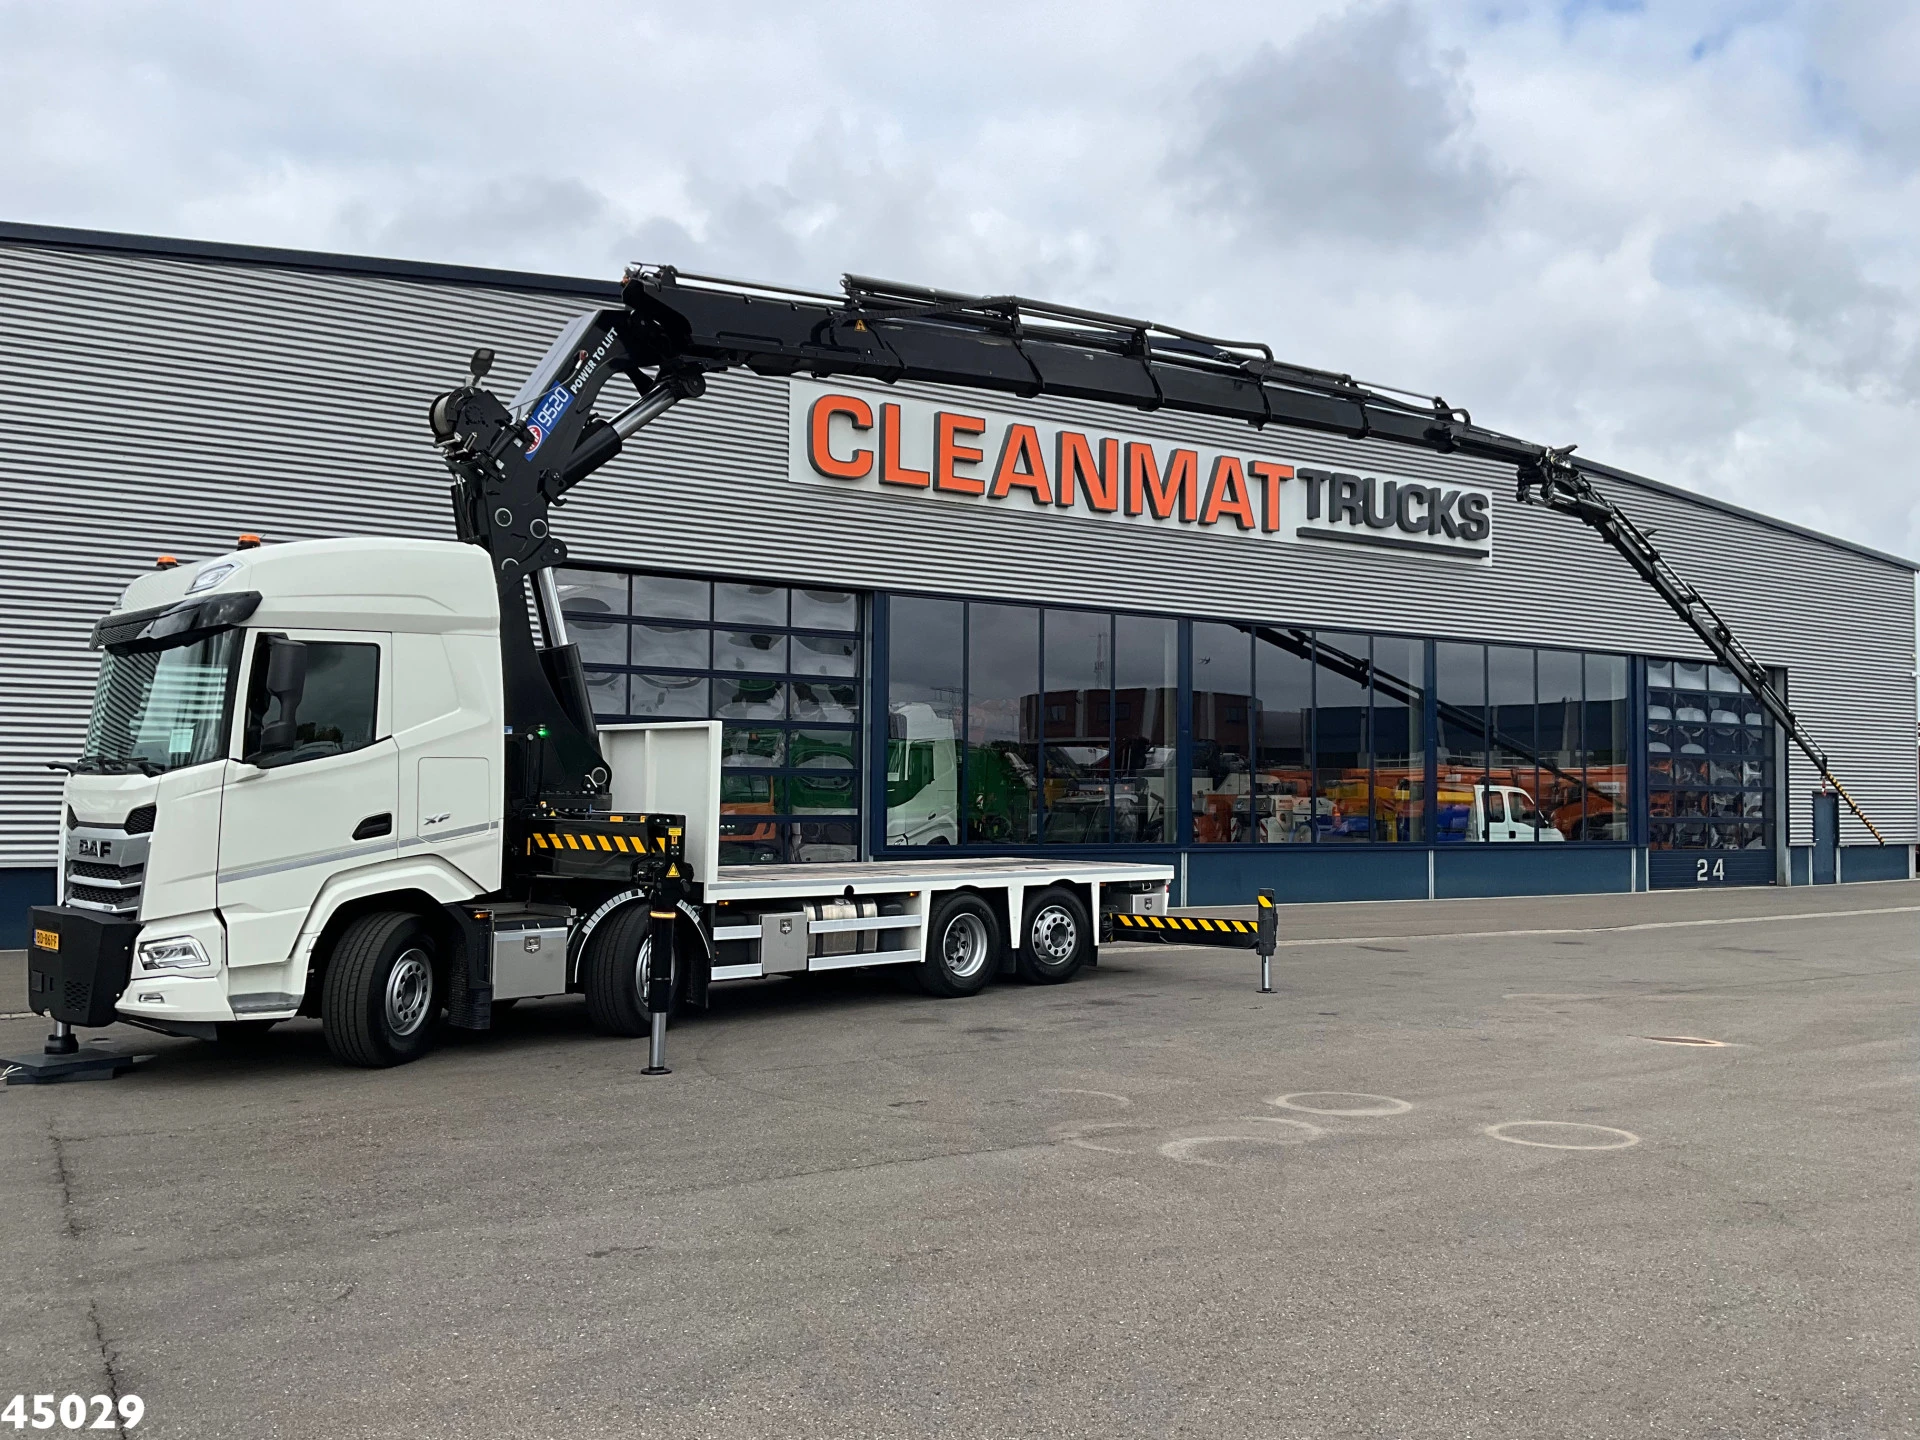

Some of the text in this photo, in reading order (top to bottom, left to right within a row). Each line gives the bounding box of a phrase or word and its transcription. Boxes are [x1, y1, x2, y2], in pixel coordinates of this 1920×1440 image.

[537, 327, 618, 427] 9520 POWER TO LIFT
[807, 393, 1490, 541] CLEANMAT TRUCKS
[424, 812, 451, 826] XF
[79, 839, 112, 858] DAF
[1697, 858, 1725, 881] 24
